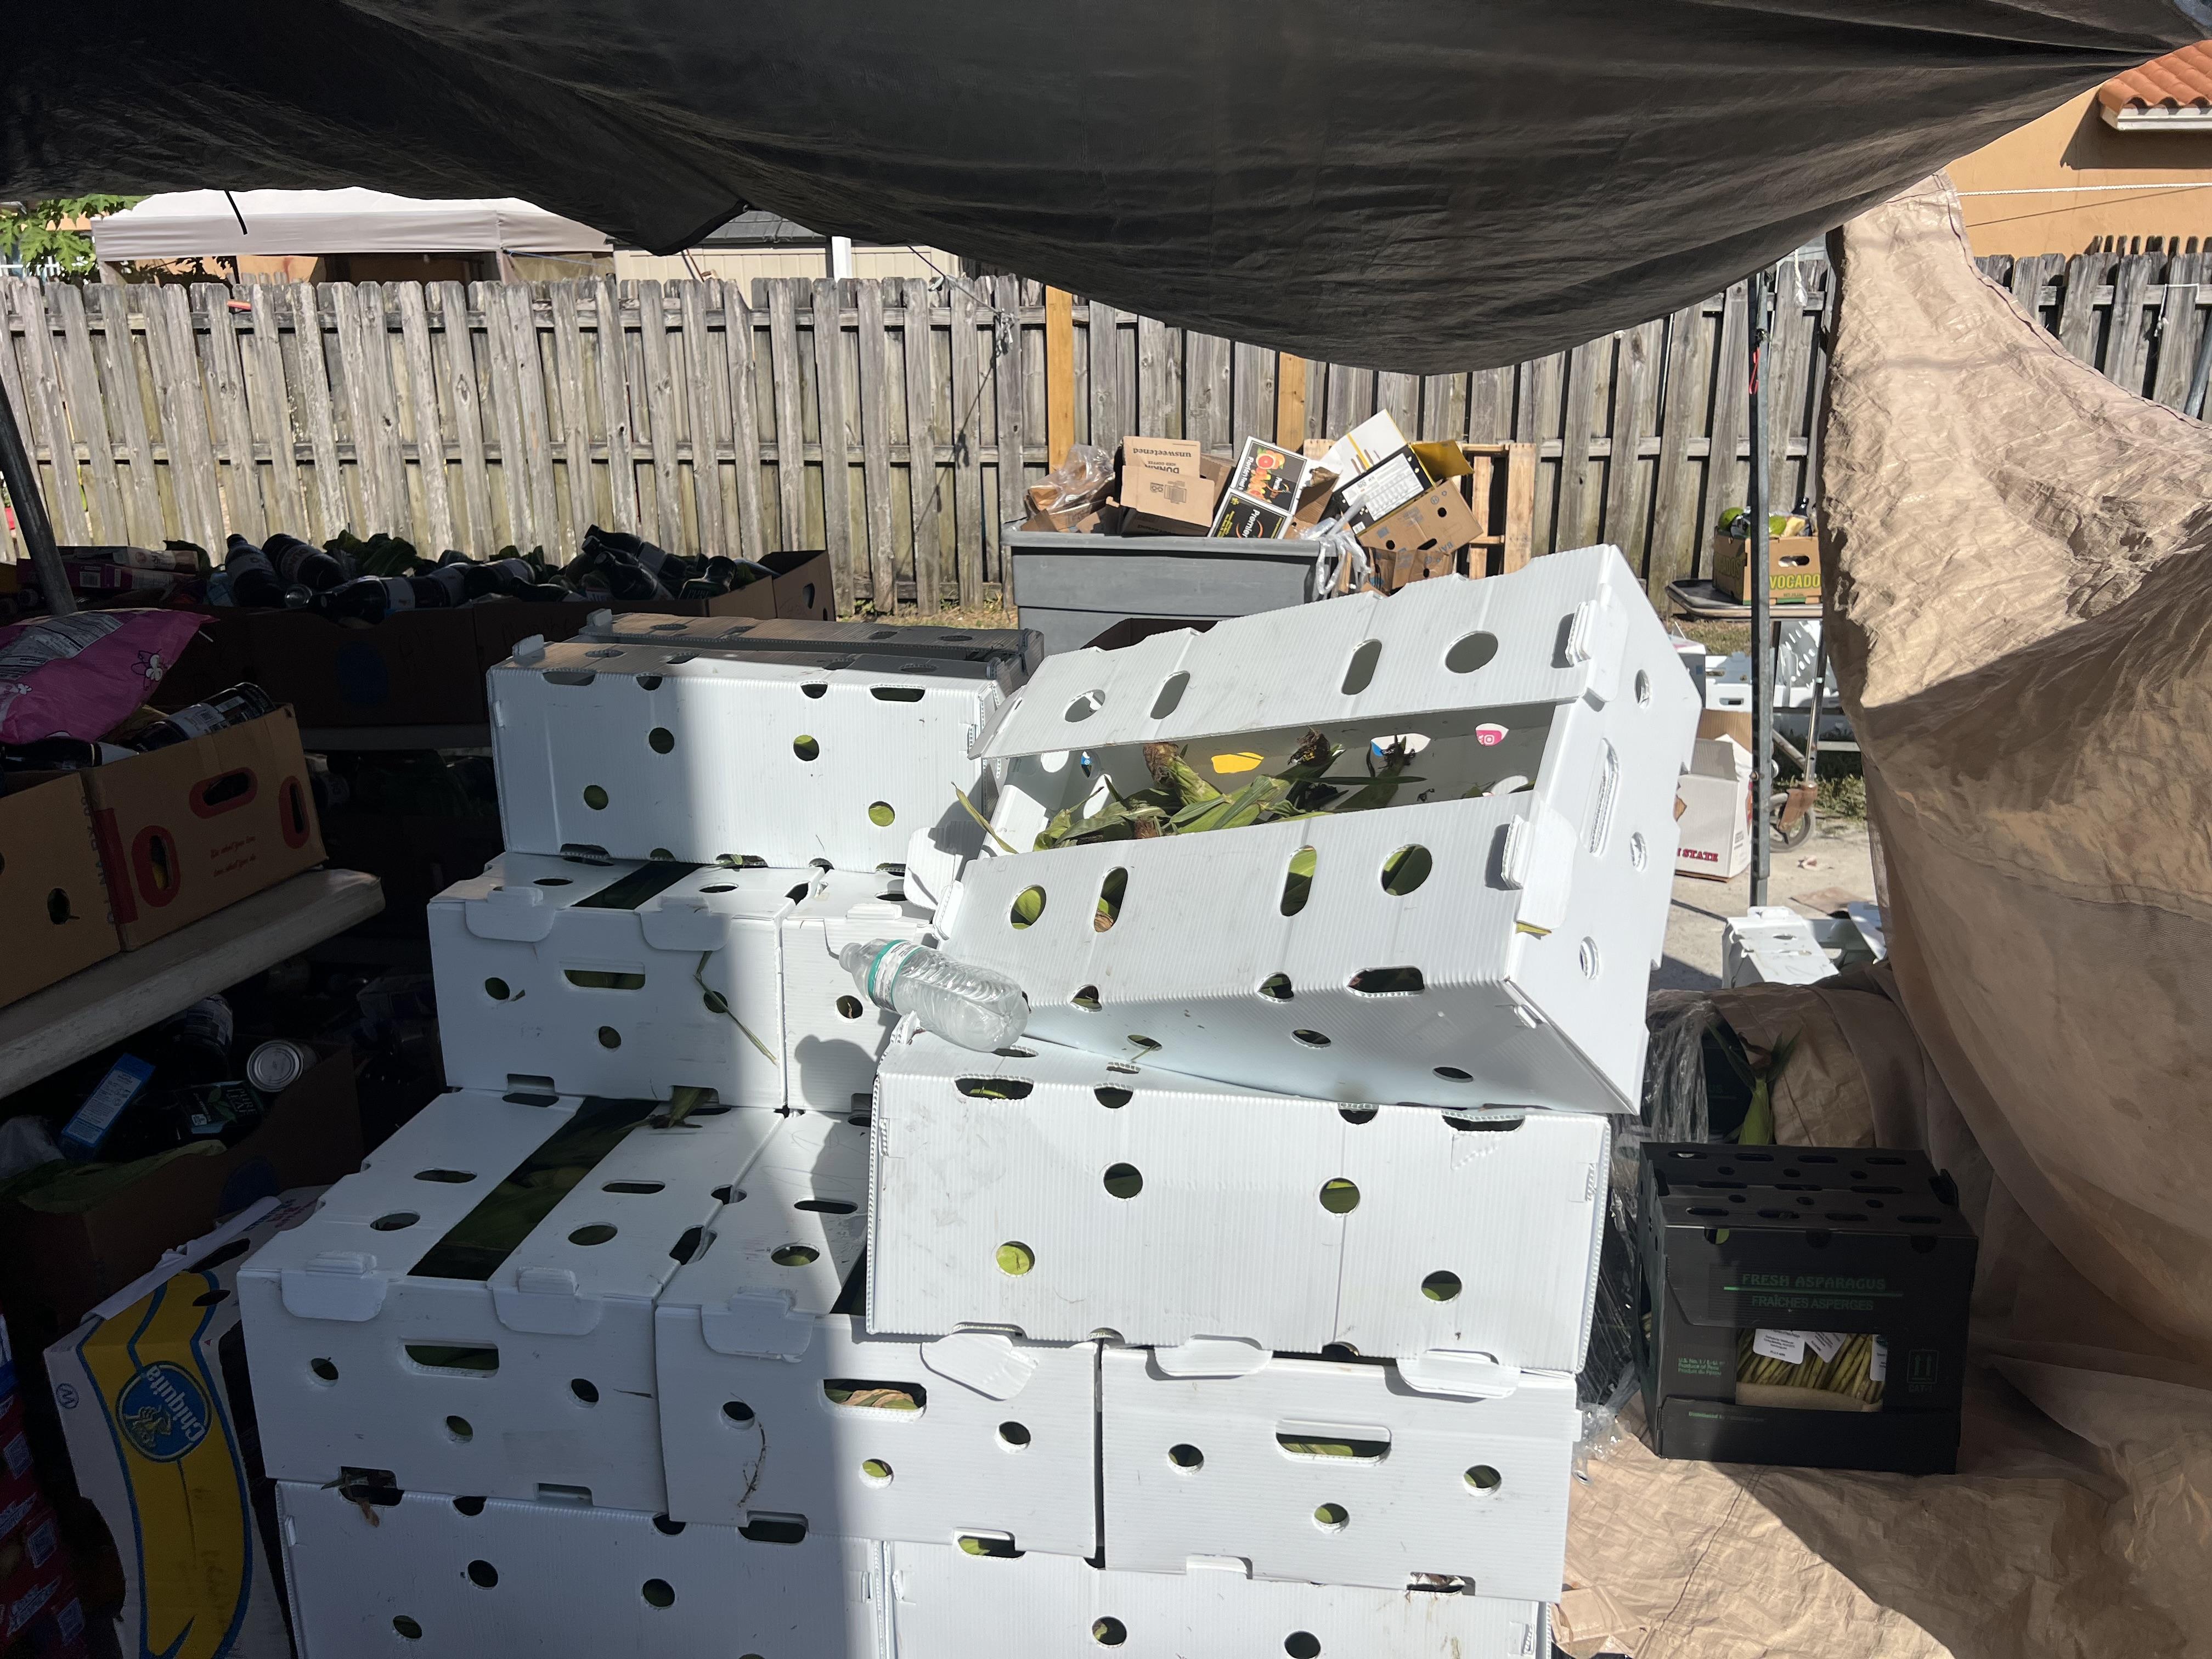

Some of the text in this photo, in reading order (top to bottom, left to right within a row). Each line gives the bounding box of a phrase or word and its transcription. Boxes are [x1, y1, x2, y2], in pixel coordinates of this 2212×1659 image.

[1132, 448, 1192, 458] unsweetened
[1683, 848, 1718, 862] STATE
[1742, 1273, 1886, 1291] FRESH ASPARAGUS
[1811, 1298, 1874, 1311] ASPERGES
[145, 1365, 205, 1442] Chiquita
